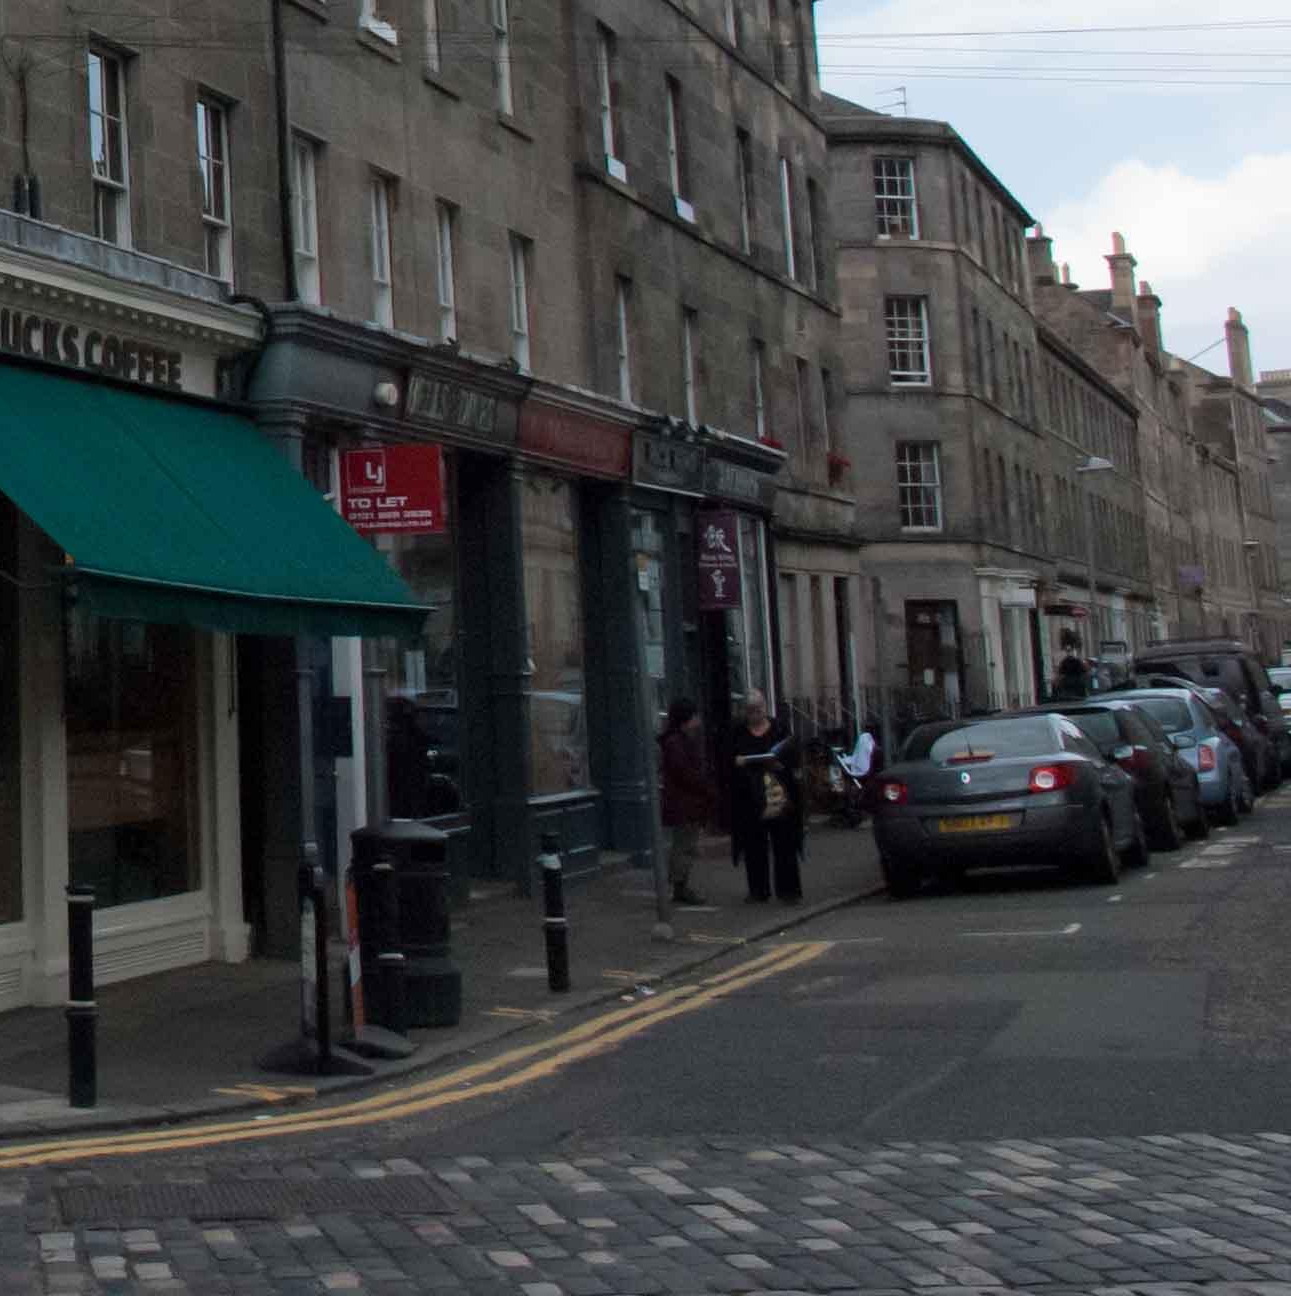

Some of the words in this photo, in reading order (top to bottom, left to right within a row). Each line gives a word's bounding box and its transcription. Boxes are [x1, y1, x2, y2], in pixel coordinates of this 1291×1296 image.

[84, 329, 183, 393] COFFEE
[347, 497, 372, 509] TO
[376, 496, 408, 508] LET
